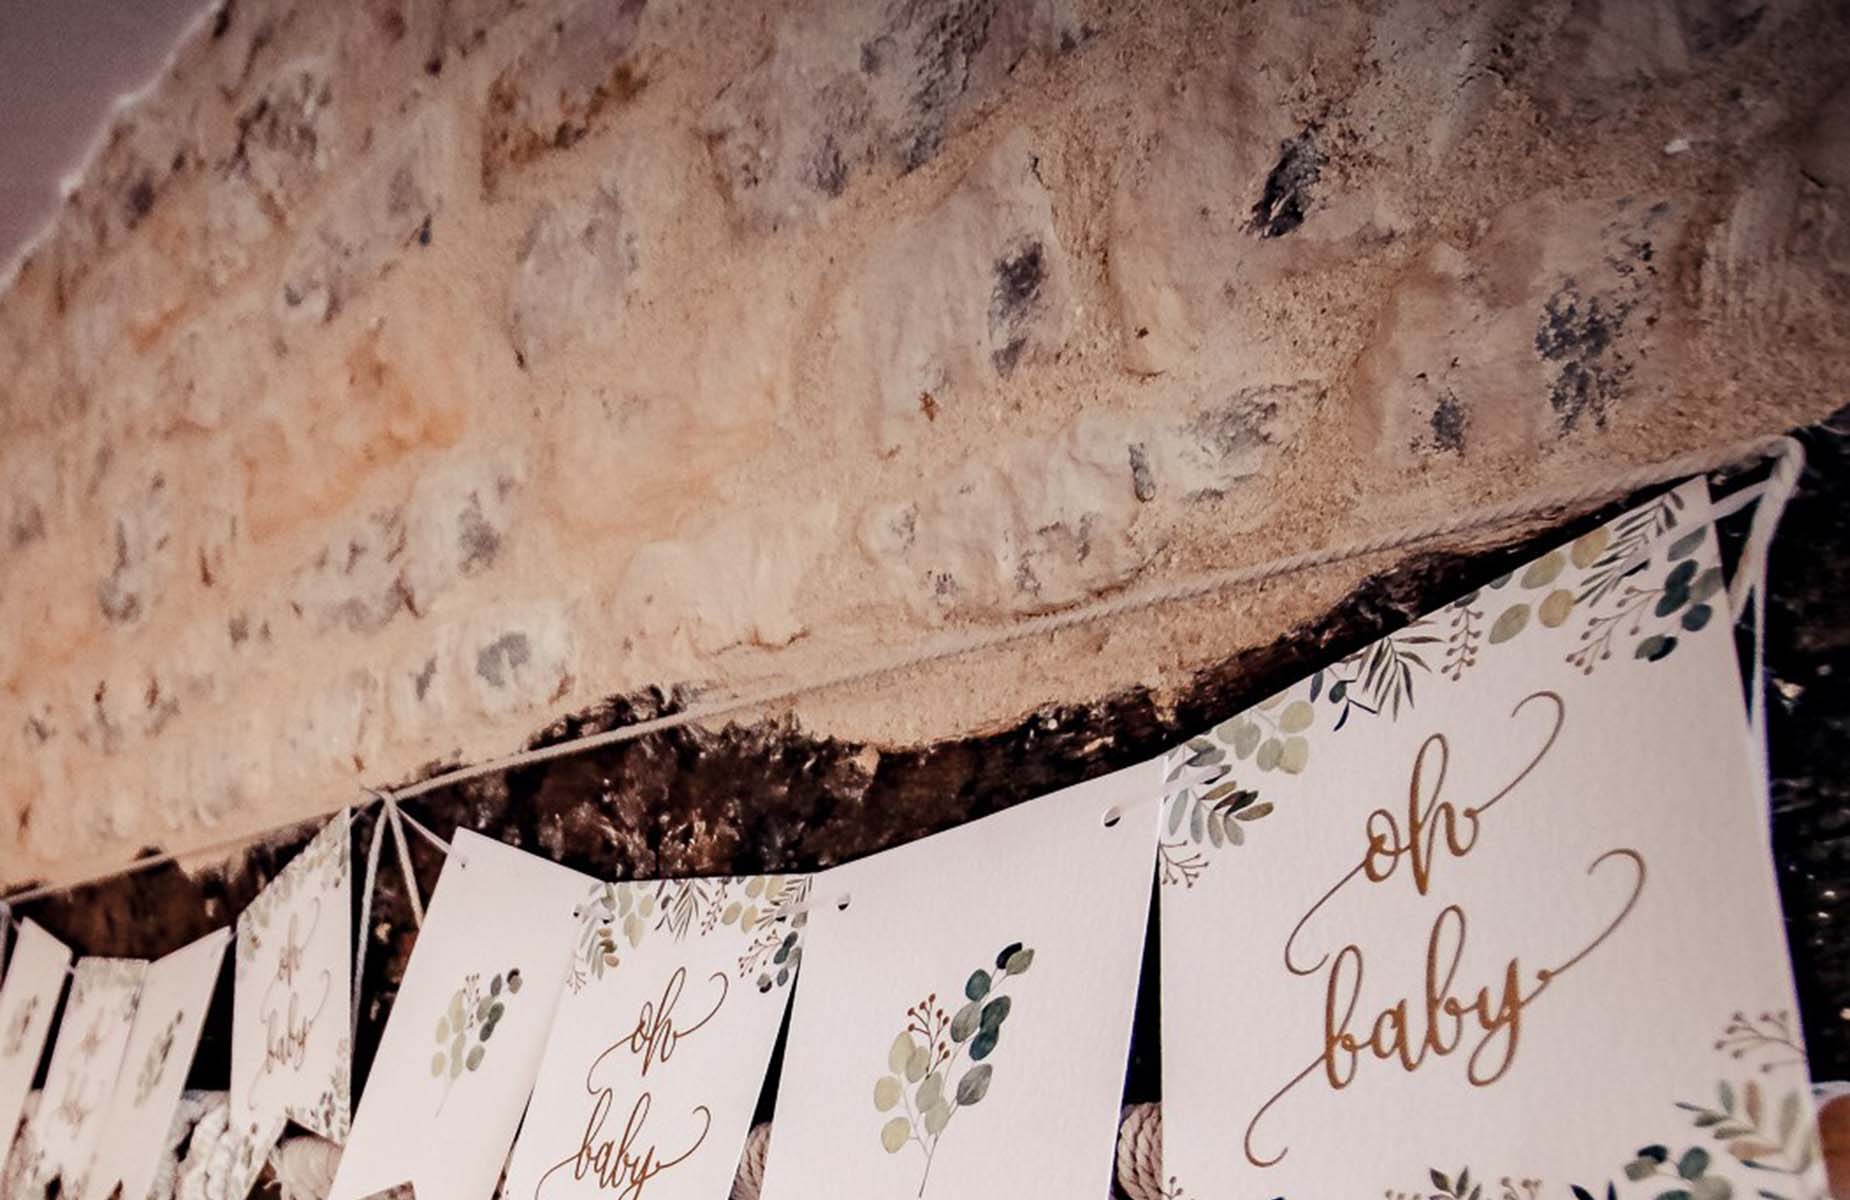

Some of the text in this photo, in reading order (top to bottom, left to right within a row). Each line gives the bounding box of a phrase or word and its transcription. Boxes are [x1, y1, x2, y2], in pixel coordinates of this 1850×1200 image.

[1285, 690, 1565, 976] oh
[587, 966, 729, 1095] oh
[1244, 848, 1646, 1168] baby
